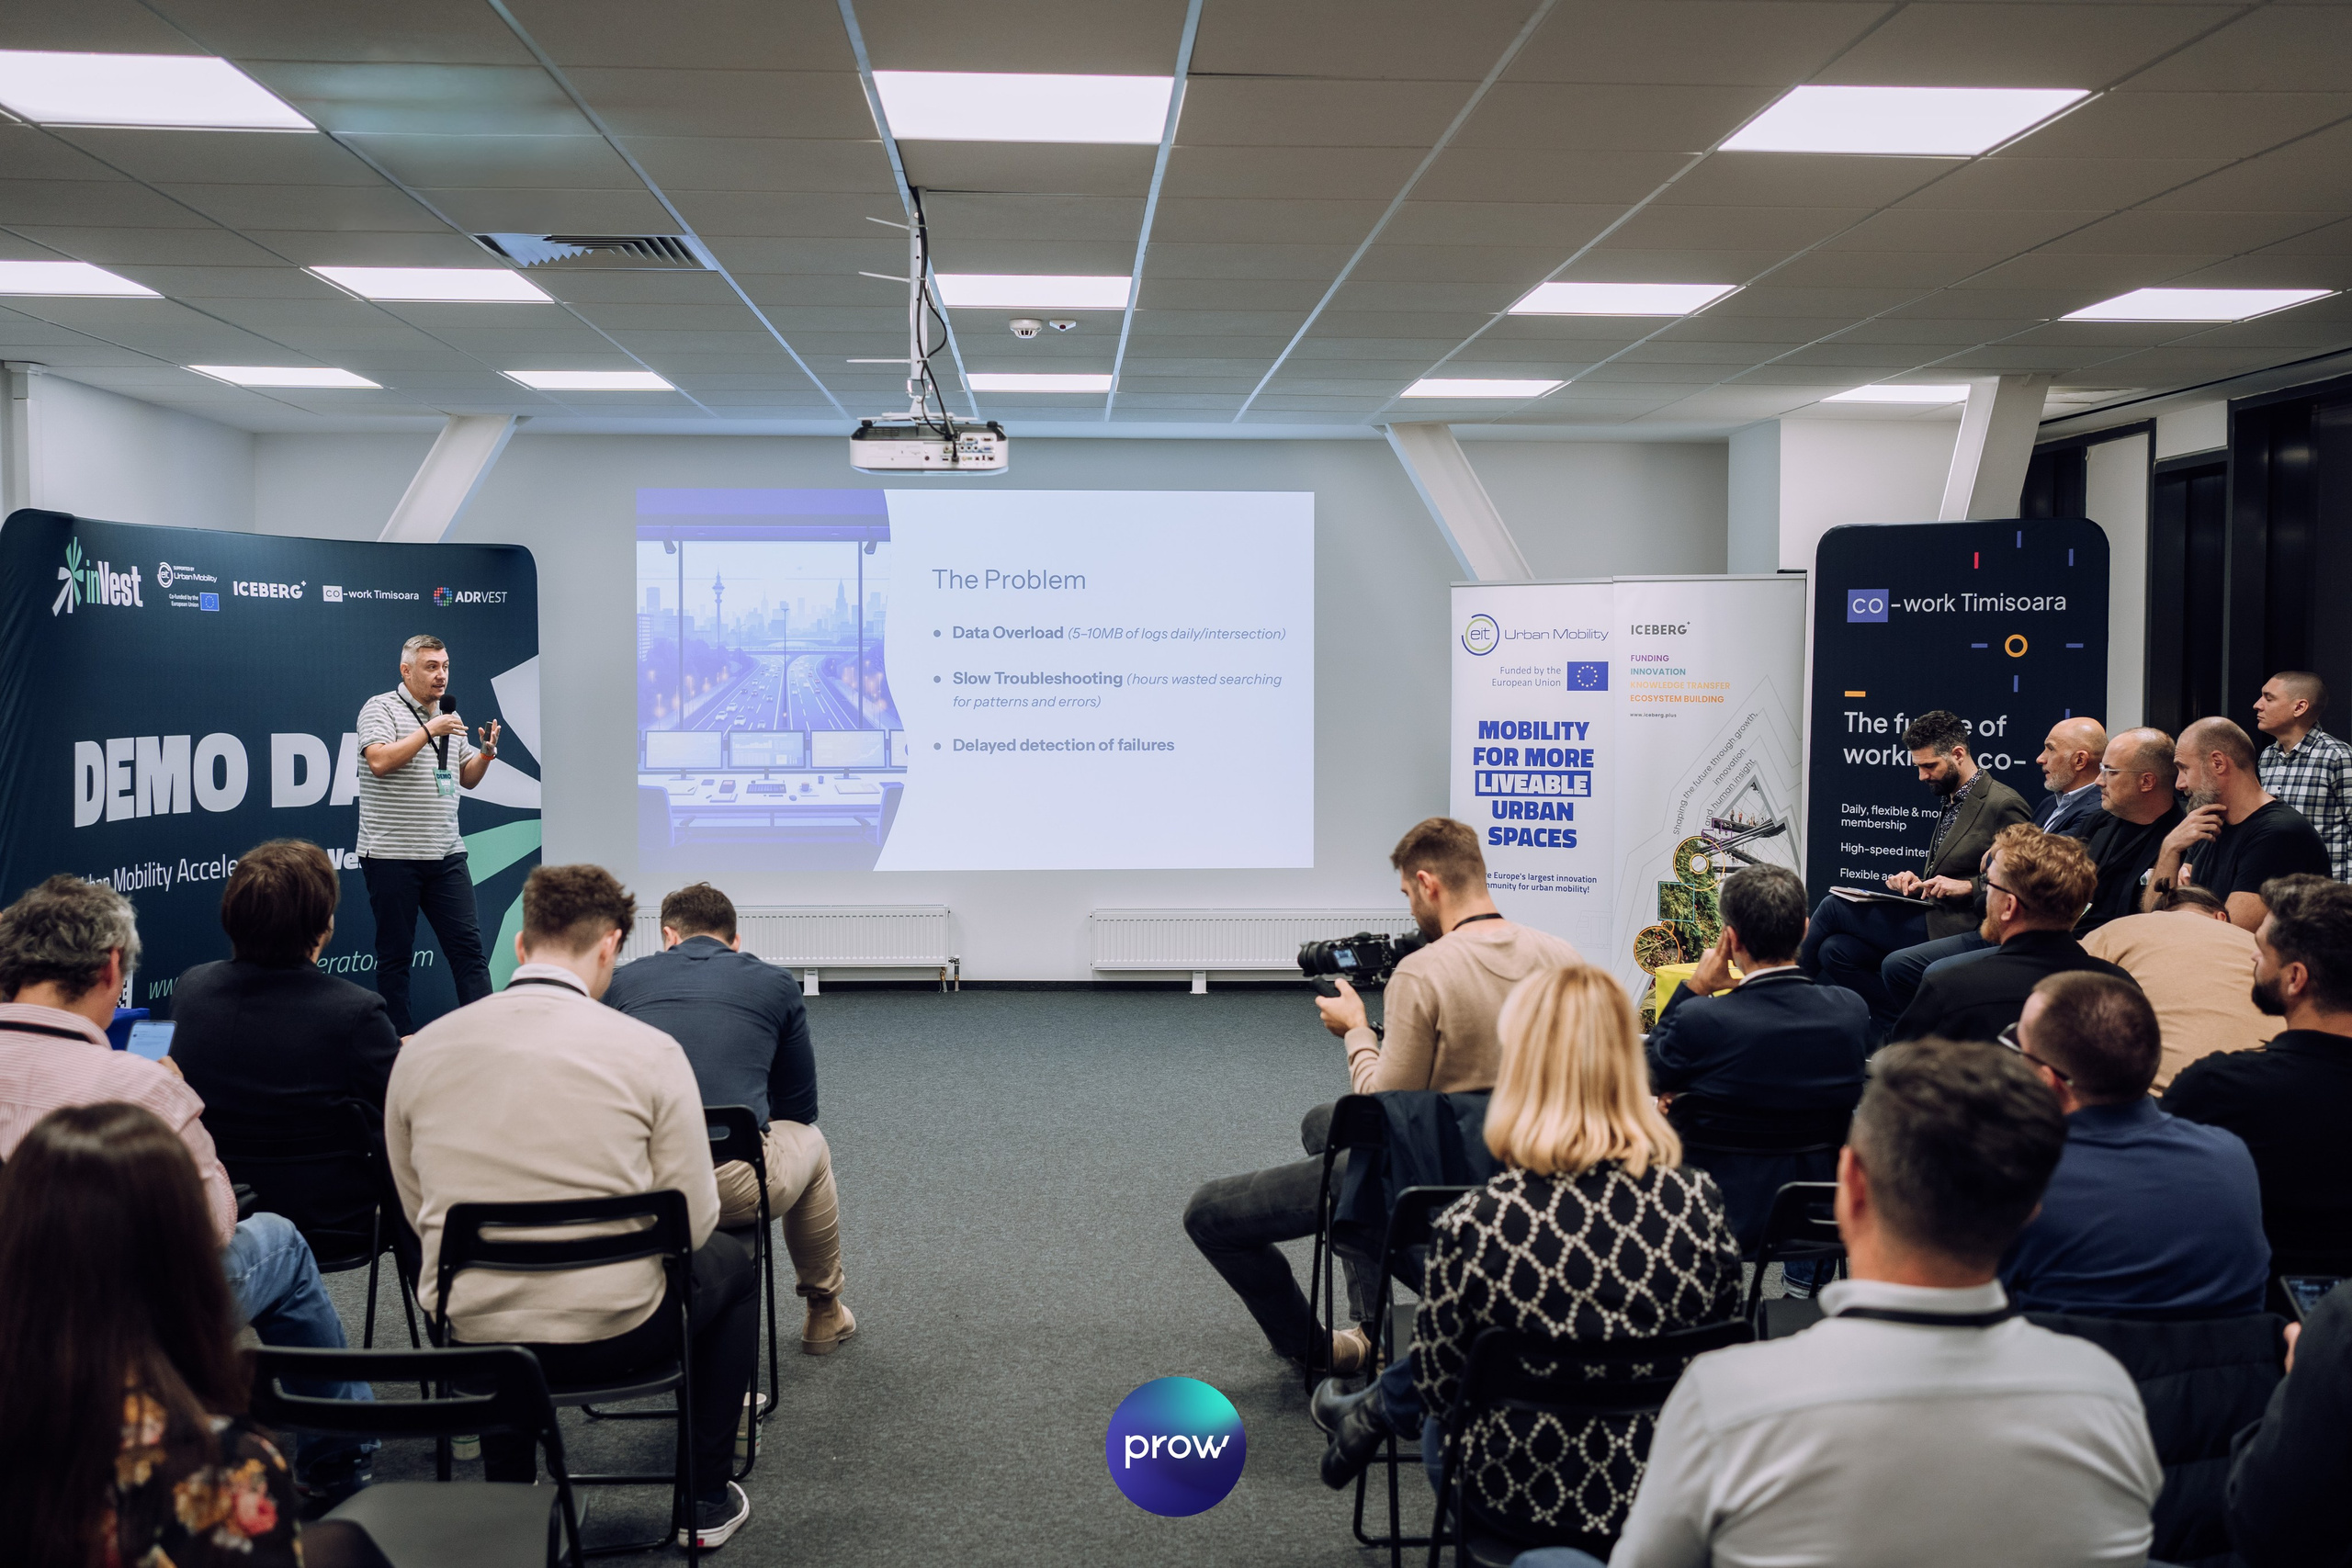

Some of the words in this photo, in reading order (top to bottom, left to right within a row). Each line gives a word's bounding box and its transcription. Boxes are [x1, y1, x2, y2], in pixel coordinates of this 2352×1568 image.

[86, 559, 143, 607] inVest
[193, 574, 218, 583] Mobility
[932, 569, 978, 590] The
[985, 569, 1086, 591] Problem
[374, 590, 420, 600] Timisoara
[1961, 592, 2067, 612] Timisoara
[952, 626, 989, 640] Data
[992, 626, 1064, 640] Overload
[1125, 627, 1139, 640] of
[1141, 627, 1169, 642] logs
[1170, 627, 1286, 642] daily/intersection)
[1470, 627, 1490, 640] eit
[1504, 629, 1550, 640] Urban
[1553, 628, 1609, 641] Mobility
[1630, 654, 1669, 662] FUNDING
[1499, 666, 1532, 675] Funded
[1534, 666, 1544, 676] by
[1547, 666, 1561, 675] the
[952, 671, 991, 685] Slow
[994, 671, 1123, 688] Troubleshooting
[1126, 672, 1169, 687] (hours
[1171, 673, 1216, 685] wasted
[1219, 673, 1283, 688] searching
[1492, 678, 1532, 688] European
[1535, 678, 1561, 687] Union
[1687, 682, 1731, 690] TRANSFER
[953, 695, 971, 708] for
[973, 696, 1029, 710] patterns
[1031, 695, 1056, 708] and
[1058, 695, 1102, 708] errors)
[1630, 694, 1681, 703] ECOSYSTEM
[1683, 695, 1724, 704] BUILDING
[1478, 720, 1590, 740] MOBILITY
[1844, 712, 1888, 733] The
[1979, 715, 2007, 737] of
[953, 739, 1017, 754] Delayed
[1020, 739, 1095, 751] detection
[1098, 739, 1117, 751] of
[1119, 739, 1175, 751] failures
[1473, 747, 1521, 768] FOR
[1524, 748, 1594, 768] MORE
[1843, 744, 1913, 767] worki
[1977, 752, 2027, 770] co-
[1673, 799, 1689, 835] Shaping
[1683, 787, 1695, 799] the
[1693, 765, 1713, 787] future
[1710, 738, 1736, 766] through
[1734, 712, 1758, 739] growth,
[1713, 748, 1747, 785] innovation
[74, 733, 248, 828] DEMO
[1478, 773, 1589, 796] LIVEABLE
[1491, 800, 1574, 822] URBAN
[1704, 809, 1713, 826] and
[1711, 783, 1736, 809] human
[1841, 803, 1869, 817] Daily,
[1871, 806, 1909, 817] flexible
[1911, 807, 1919, 818] &
[1841, 818, 1907, 831] membership
[1487, 827, 1577, 849] SPACES
[1840, 842, 1904, 856] High-speed
[1905, 847, 1930, 857] inter
[114, 862, 173, 892] Mobility
[176, 853, 239, 883] Accele
[1494, 872, 1526, 881] Europe's
[1528, 874, 1555, 883] largest
[1556, 874, 1597, 884] innovation
[1840, 868, 1880, 881] Flexible
[1555, 885, 1589, 895] mobility!
